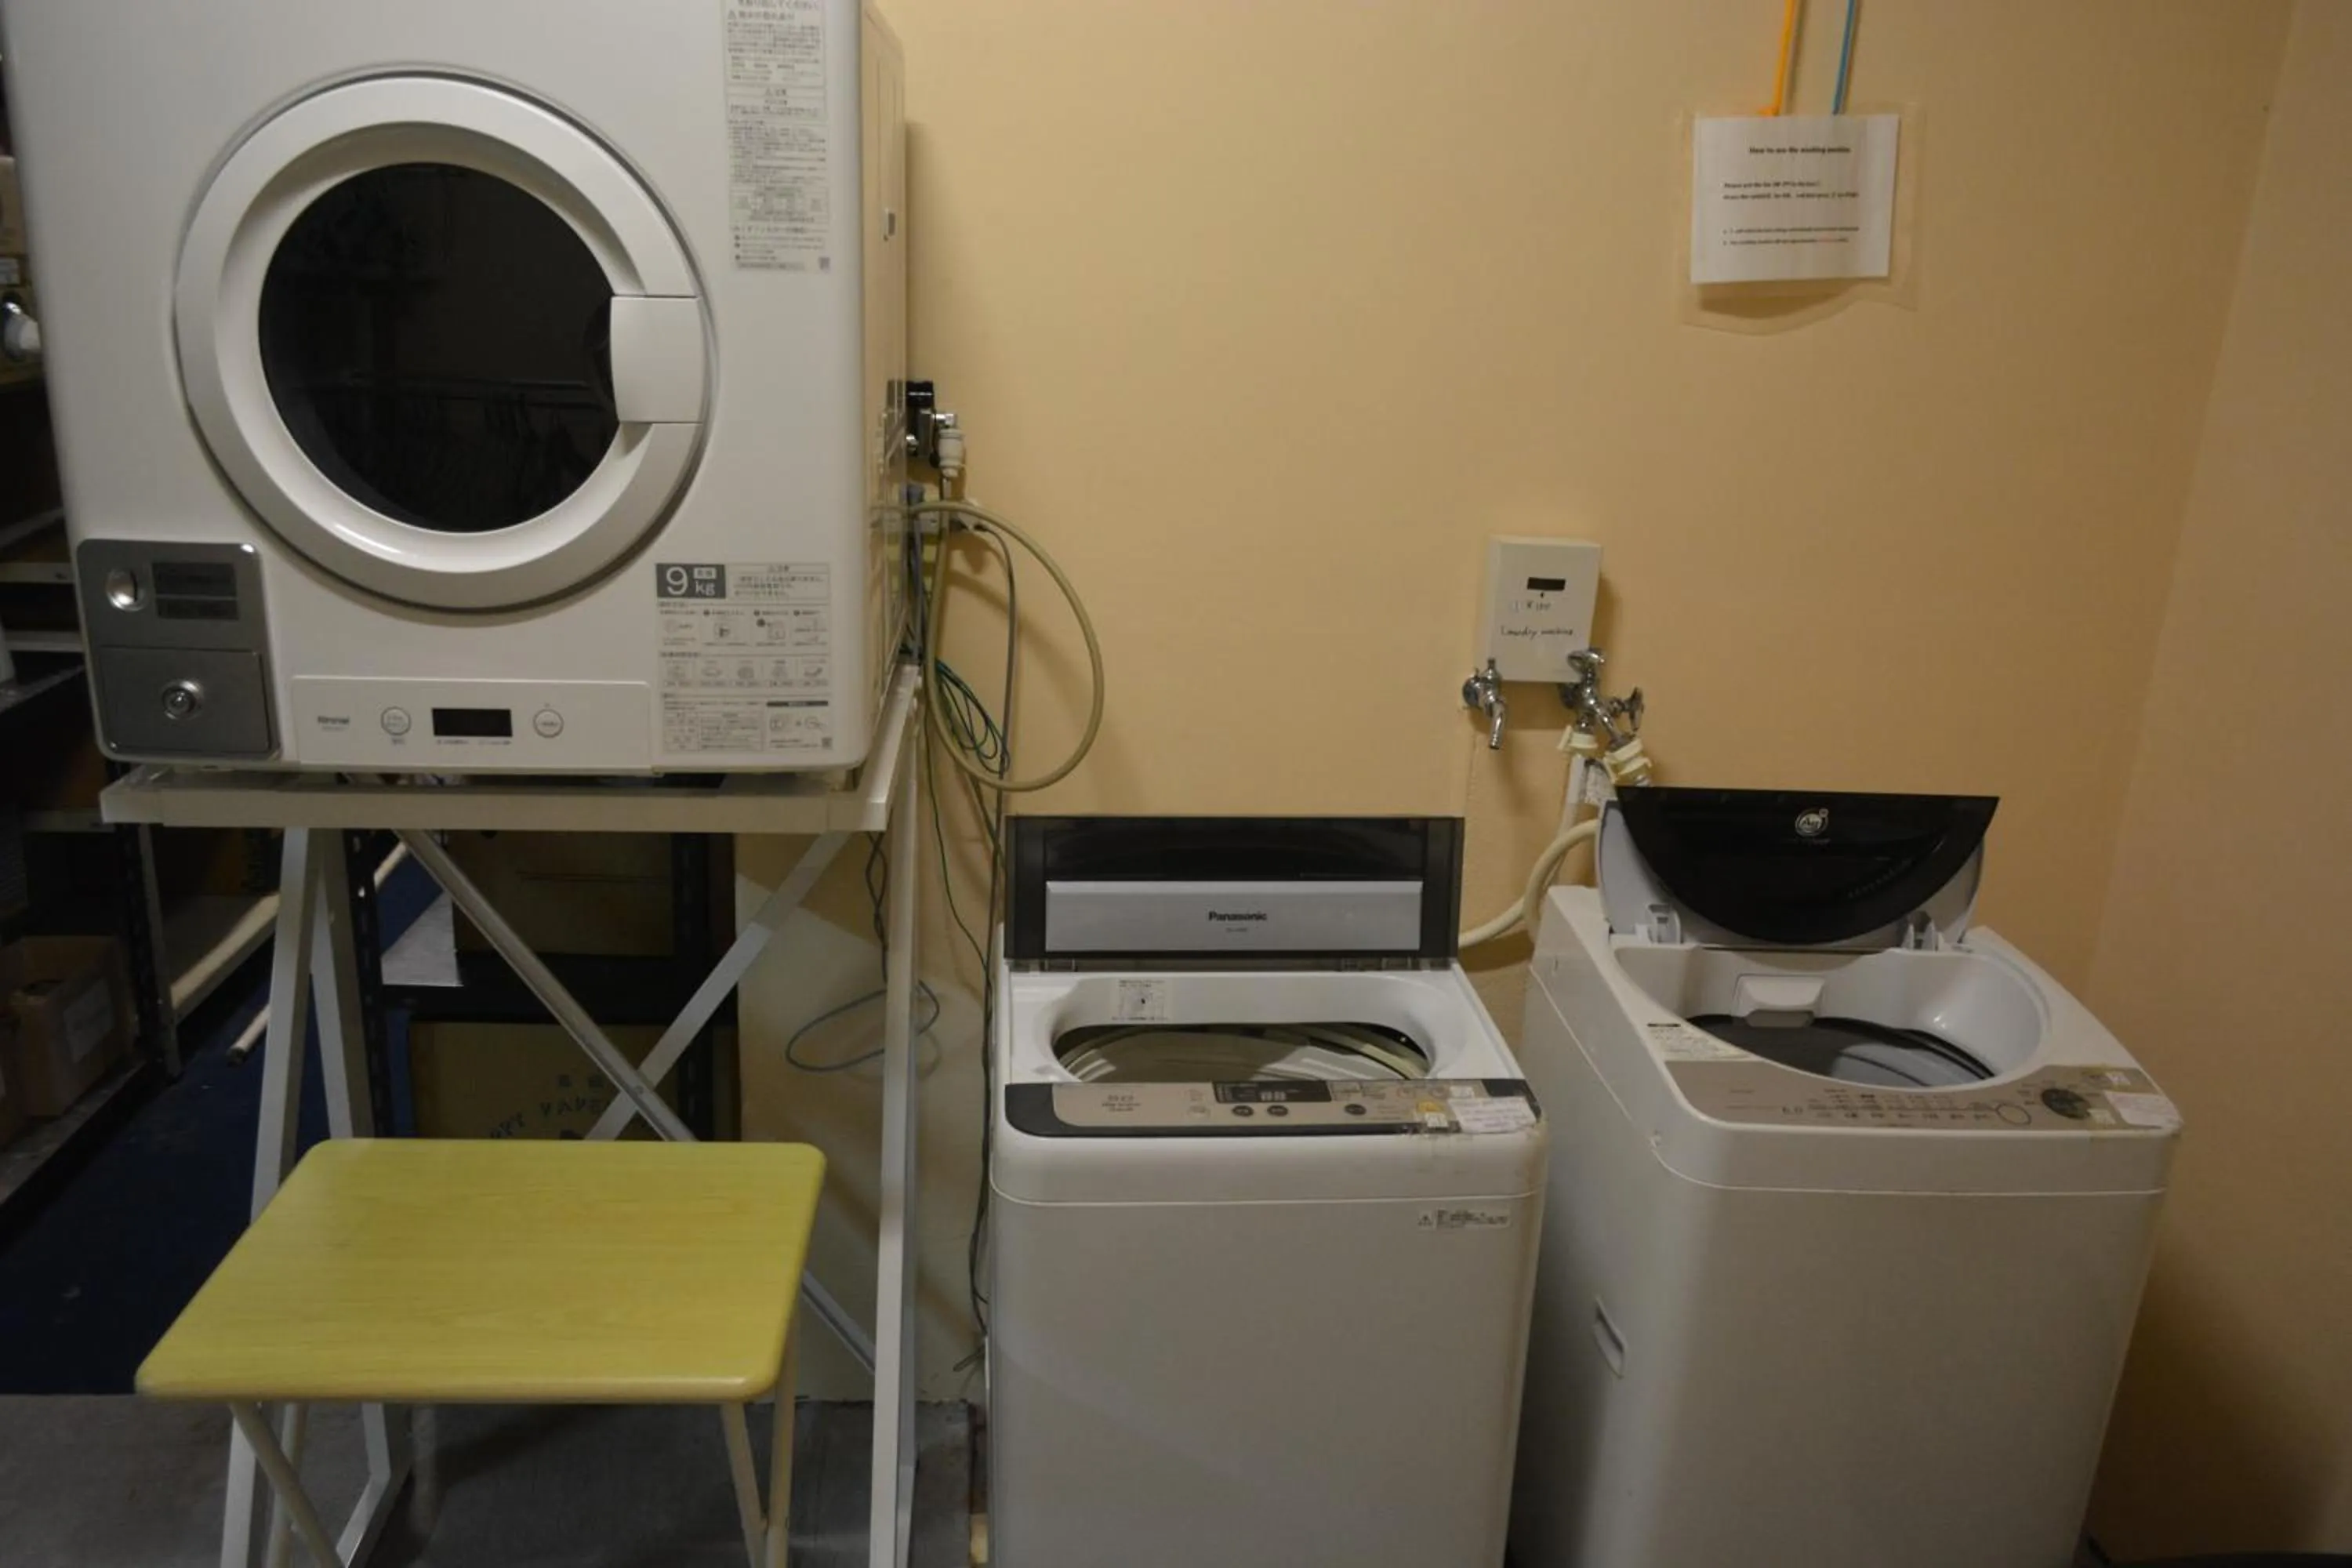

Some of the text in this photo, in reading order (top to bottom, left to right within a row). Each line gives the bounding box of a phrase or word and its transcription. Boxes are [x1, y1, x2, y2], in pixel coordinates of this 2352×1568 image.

[666, 566, 688, 595] 9
[695, 581, 716, 596] kg
[1208, 911, 1268, 921] Panasonic
